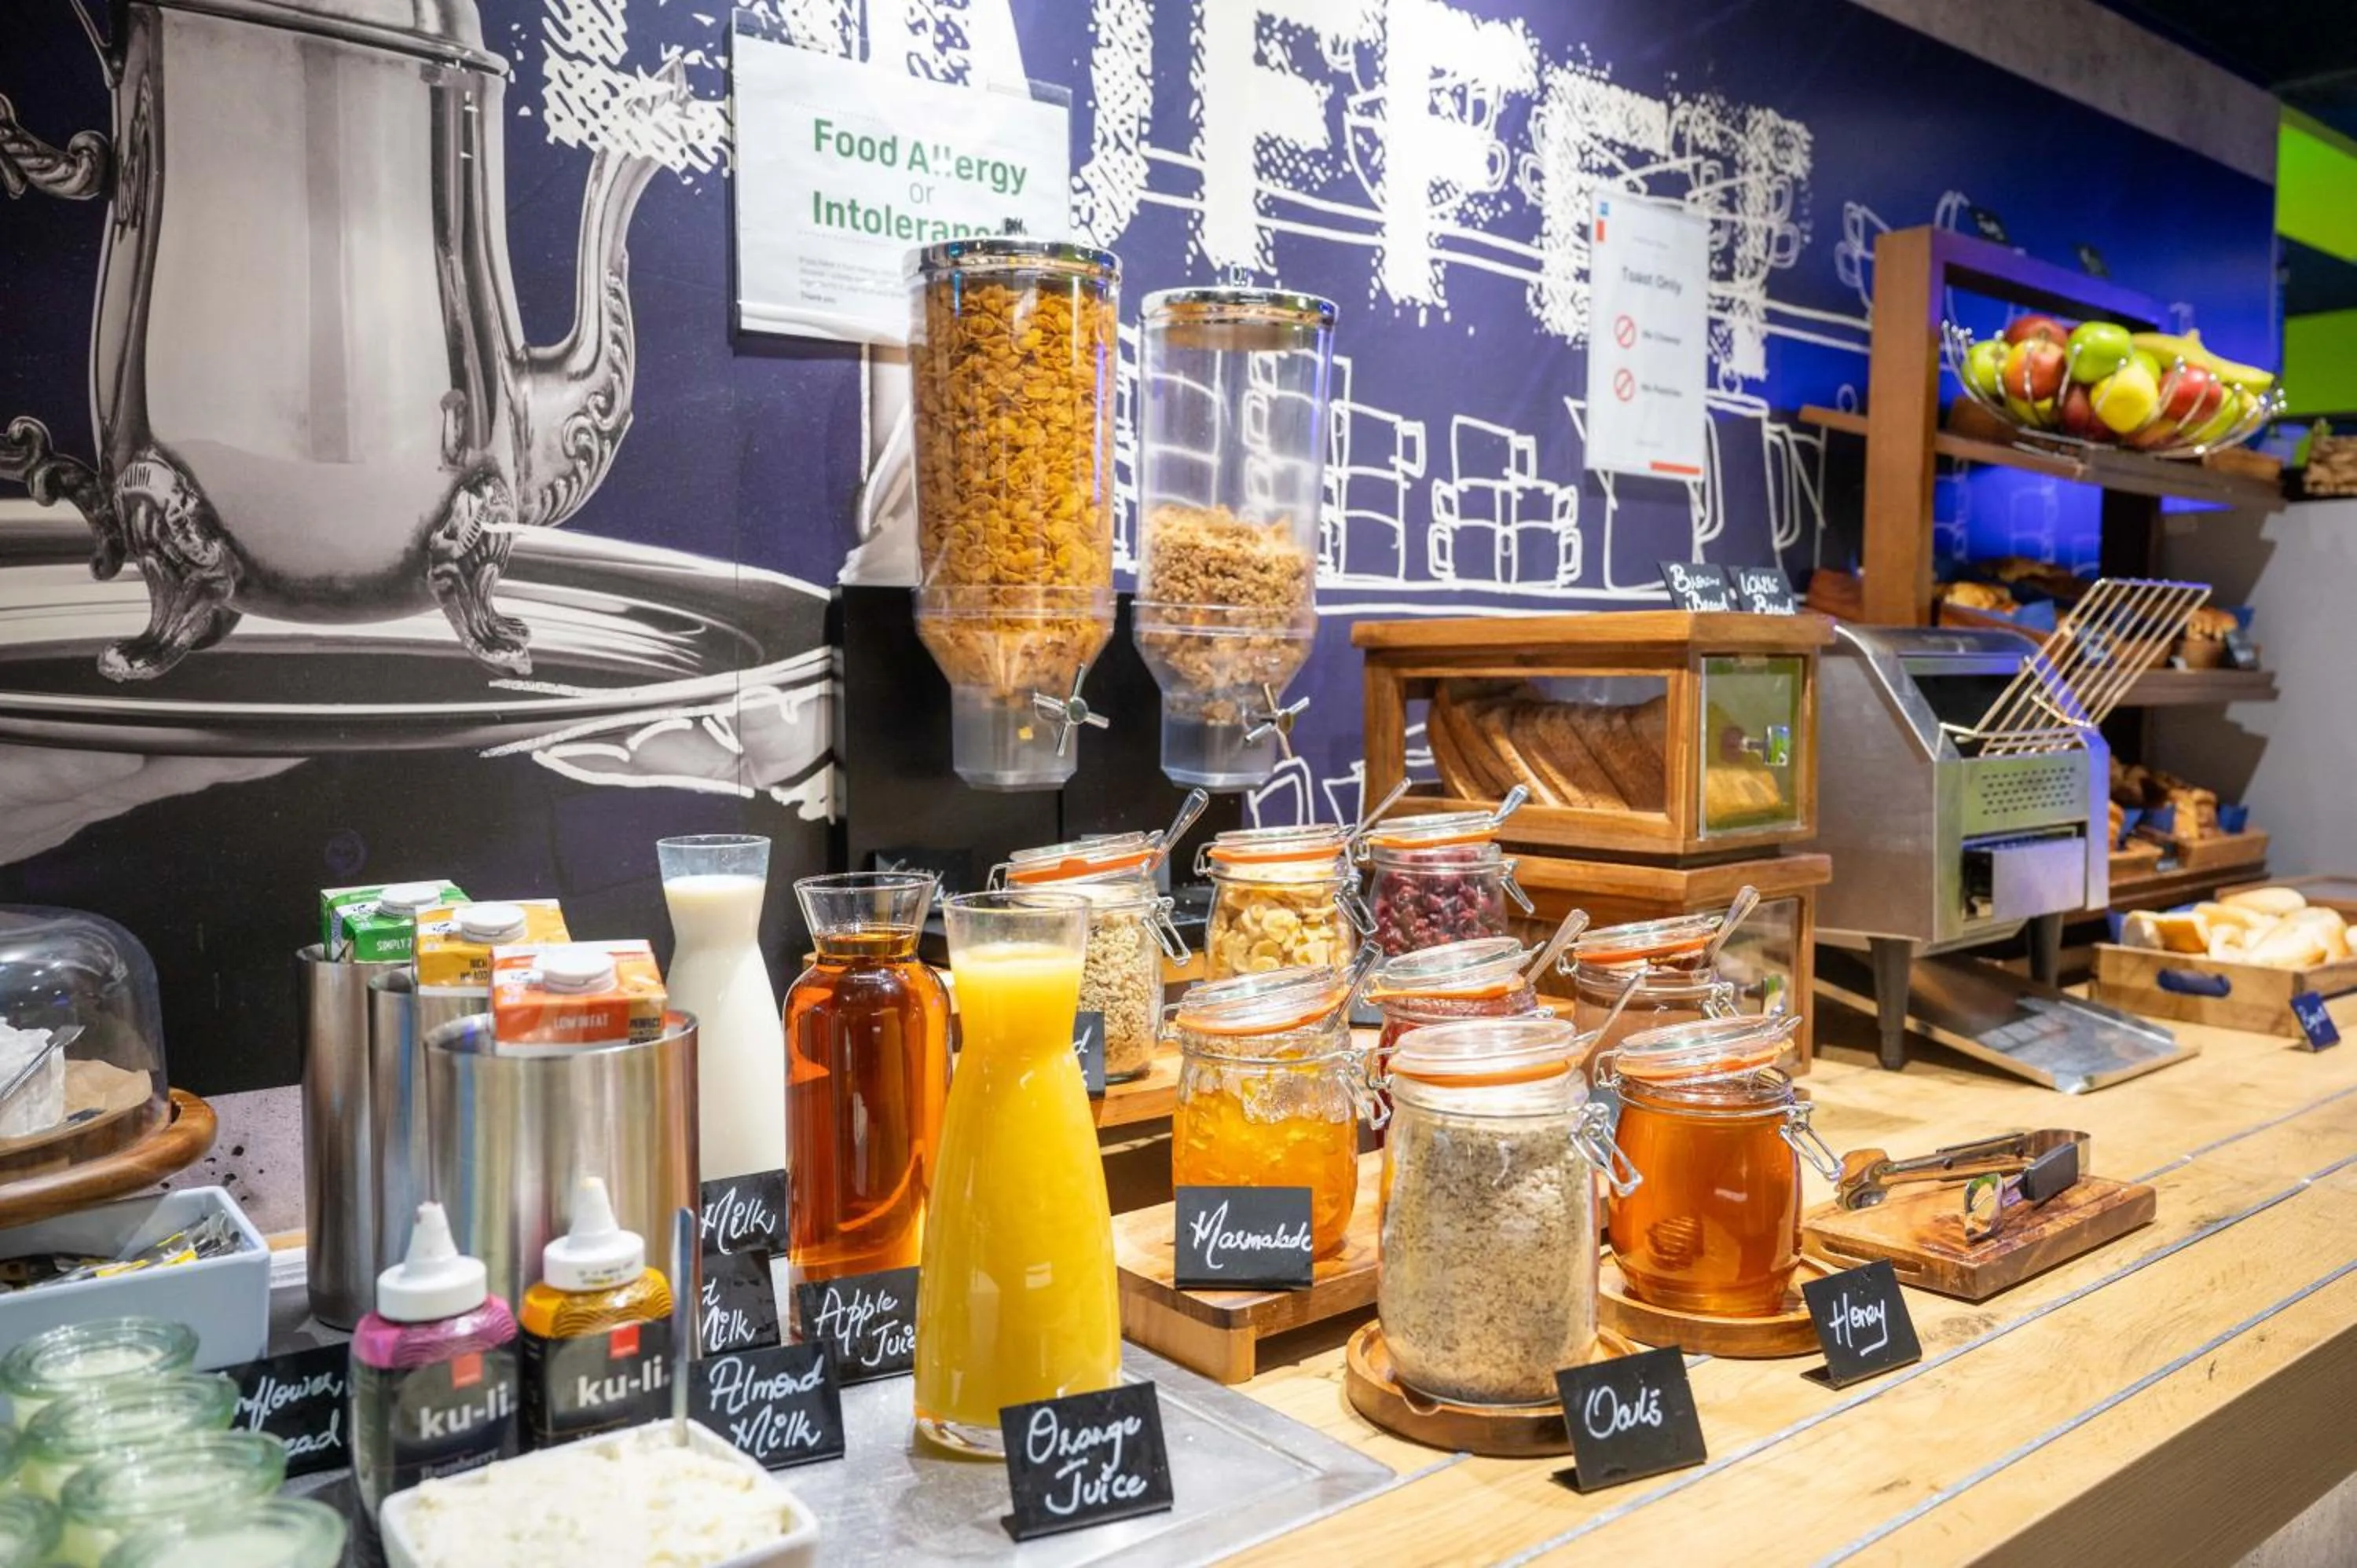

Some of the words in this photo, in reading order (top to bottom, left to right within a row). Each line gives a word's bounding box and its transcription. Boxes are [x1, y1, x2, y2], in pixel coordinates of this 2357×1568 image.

[814, 118, 898, 167] Food
[812, 190, 1002, 240] Intoleran
[909, 182, 935, 205] or
[701, 1187, 775, 1255] Milk
[1190, 1200, 1313, 1269] Marmalade
[814, 1288, 898, 1357] Apple
[861, 1321, 915, 1366] Juic
[1829, 1292, 1888, 1357] Honey
[710, 1354, 825, 1413] Almond
[730, 1405, 821, 1457] Milk
[1585, 1385, 1662, 1440] Oats
[1027, 1407, 1142, 1478] Orange
[1045, 1458, 1147, 1515] Juice
